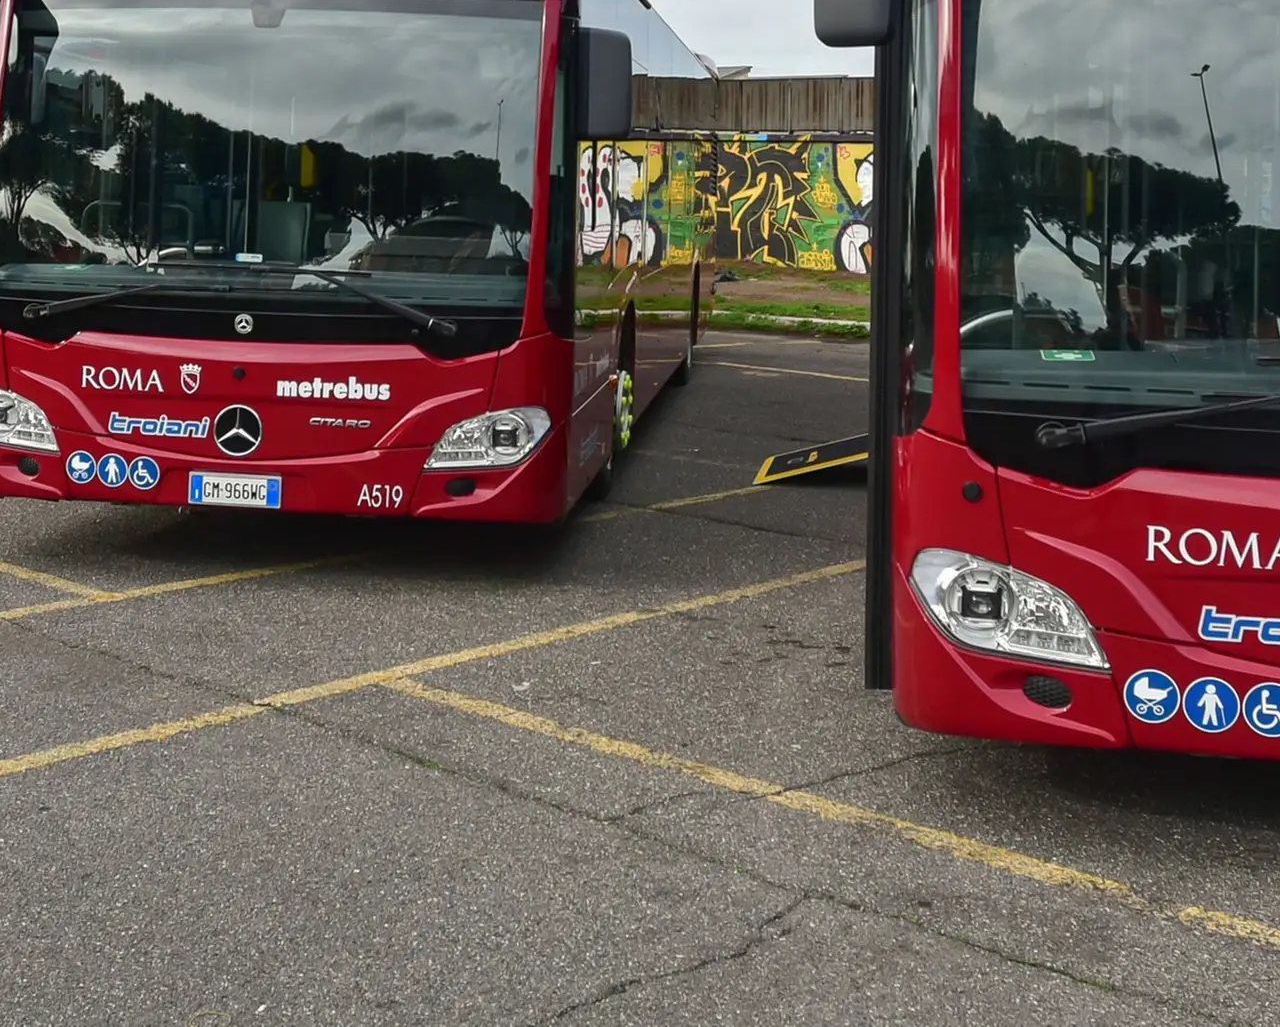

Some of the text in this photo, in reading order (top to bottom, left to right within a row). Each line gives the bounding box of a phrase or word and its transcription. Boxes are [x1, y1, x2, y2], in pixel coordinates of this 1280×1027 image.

[81, 365, 164, 393] ROMA
[276, 376, 391, 401] metrebus
[108, 412, 210, 438] troiani
[309, 417, 371, 428] CITARO
[357, 483, 403, 508] A519
